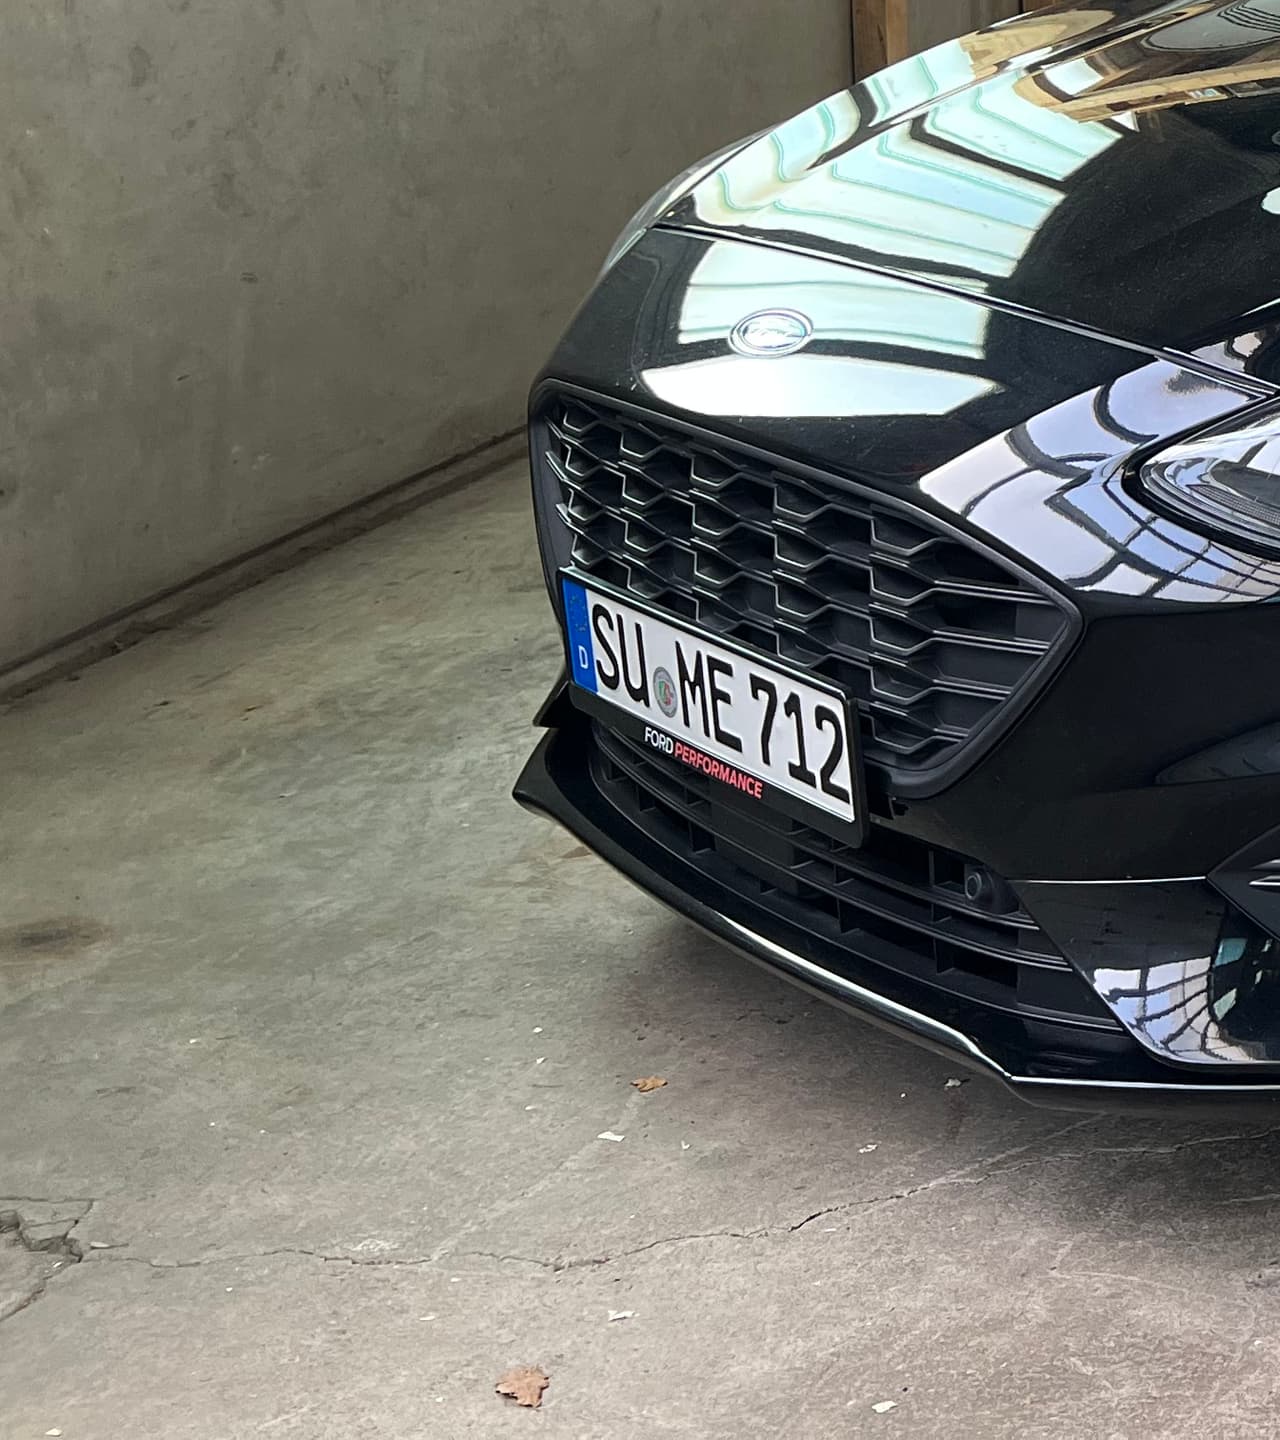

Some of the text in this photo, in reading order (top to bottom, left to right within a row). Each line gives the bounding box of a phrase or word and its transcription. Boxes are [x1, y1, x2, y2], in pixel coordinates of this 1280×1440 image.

[578, 645, 589, 669] D
[591, 603, 851, 805] SU ME 712
[644, 726, 764, 800] FORD PERFORMANCE
